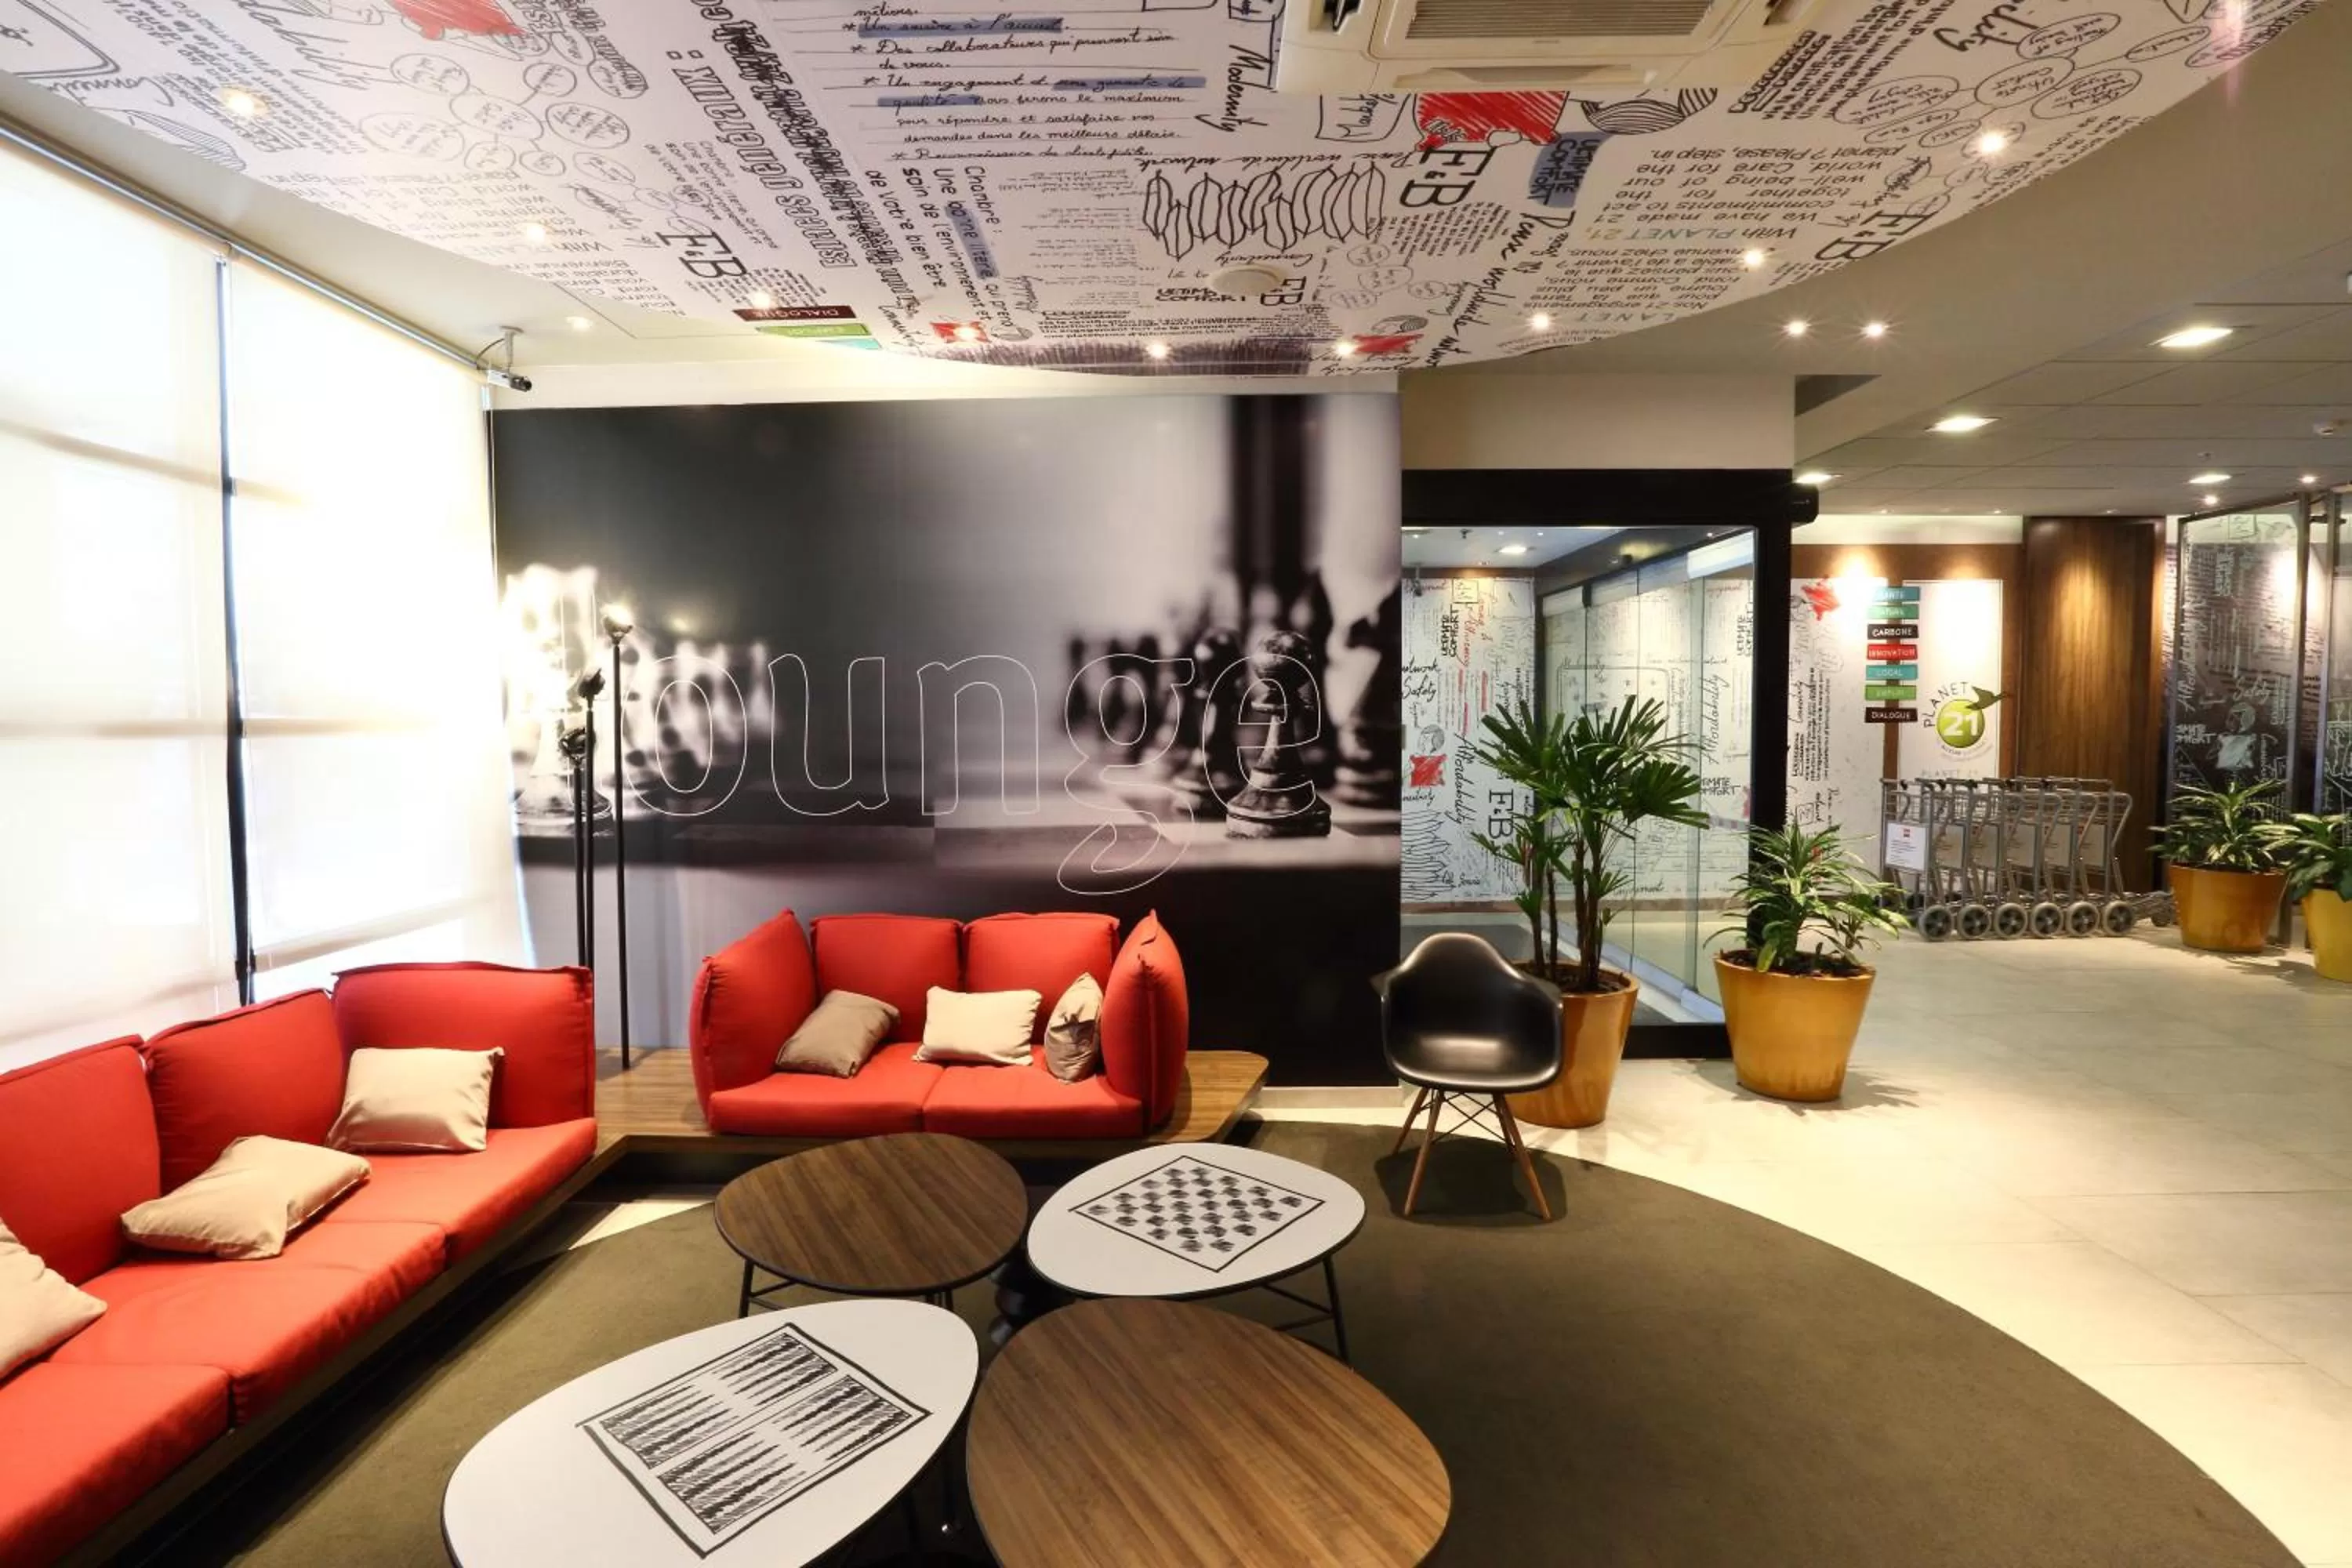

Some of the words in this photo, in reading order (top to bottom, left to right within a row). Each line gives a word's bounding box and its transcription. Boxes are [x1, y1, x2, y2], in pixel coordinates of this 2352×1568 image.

[1194, 45, 1274, 132] Modernity
[1676, 147, 1726, 160] step
[1831, 144, 1907, 158] planet
[1636, 163, 1676, 176] the
[1685, 162, 1723, 175] for
[1733, 162, 1795, 175] Care
[933, 168, 957, 195] Une
[1623, 177, 1666, 187] our
[1678, 176, 1708, 189] of
[902, 166, 930, 198] soin
[920, 202, 940, 219] de
[1615, 191, 1653, 201] the
[1682, 189, 1719, 200] for
[1746, 187, 1851, 199] together
[1602, 203, 1642, 212] act
[1646, 201, 1669, 211] to
[1676, 200, 1835, 211] commitments
[1593, 214, 1625, 223] 21
[1636, 212, 1703, 223] made
[1713, 212, 1772, 222] have
[865, 169, 887, 188] de
[906, 234, 931, 261] bien
[922, 262, 948, 289] être
[1621, 228, 1739, 240] PLANET
[1741, 227, 1798, 239] With
[1871, 628, 1912, 637] CARBONE
[1868, 648, 1915, 657] INNOVATION
[1876, 668, 1904, 677] LOCAL
[1402, 675, 1437, 703] Safety
[1923, 681, 1969, 728] PLANET
[1871, 711, 1911, 720] DIALOGUE
[1942, 711, 1980, 737] 21
[1444, 732, 1479, 824] Affordability
